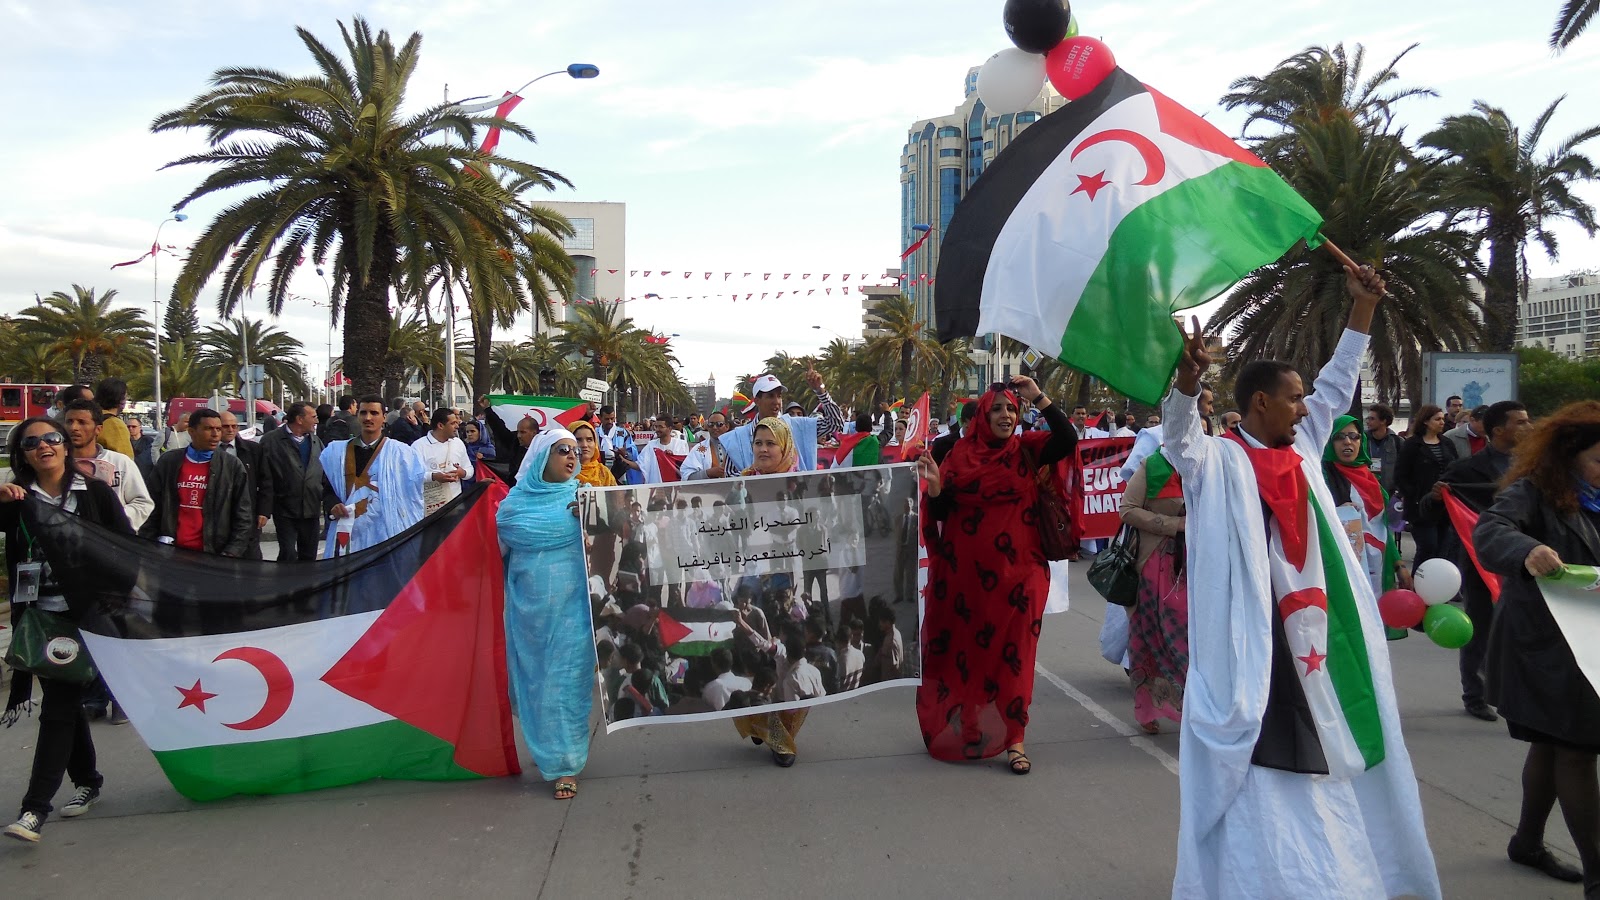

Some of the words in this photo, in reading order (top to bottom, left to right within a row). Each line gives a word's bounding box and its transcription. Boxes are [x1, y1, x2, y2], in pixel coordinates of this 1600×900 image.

[1064, 45, 1080, 72] LIBRE
[1072, 45, 1094, 80] SAHARA
[1083, 466, 1124, 491] EUP
[753, 512, 813, 532] الصحراء
[735, 547, 806, 567] مستعمرة
[808, 537, 832, 560] أخر
[677, 552, 731, 571] بافريقيا
